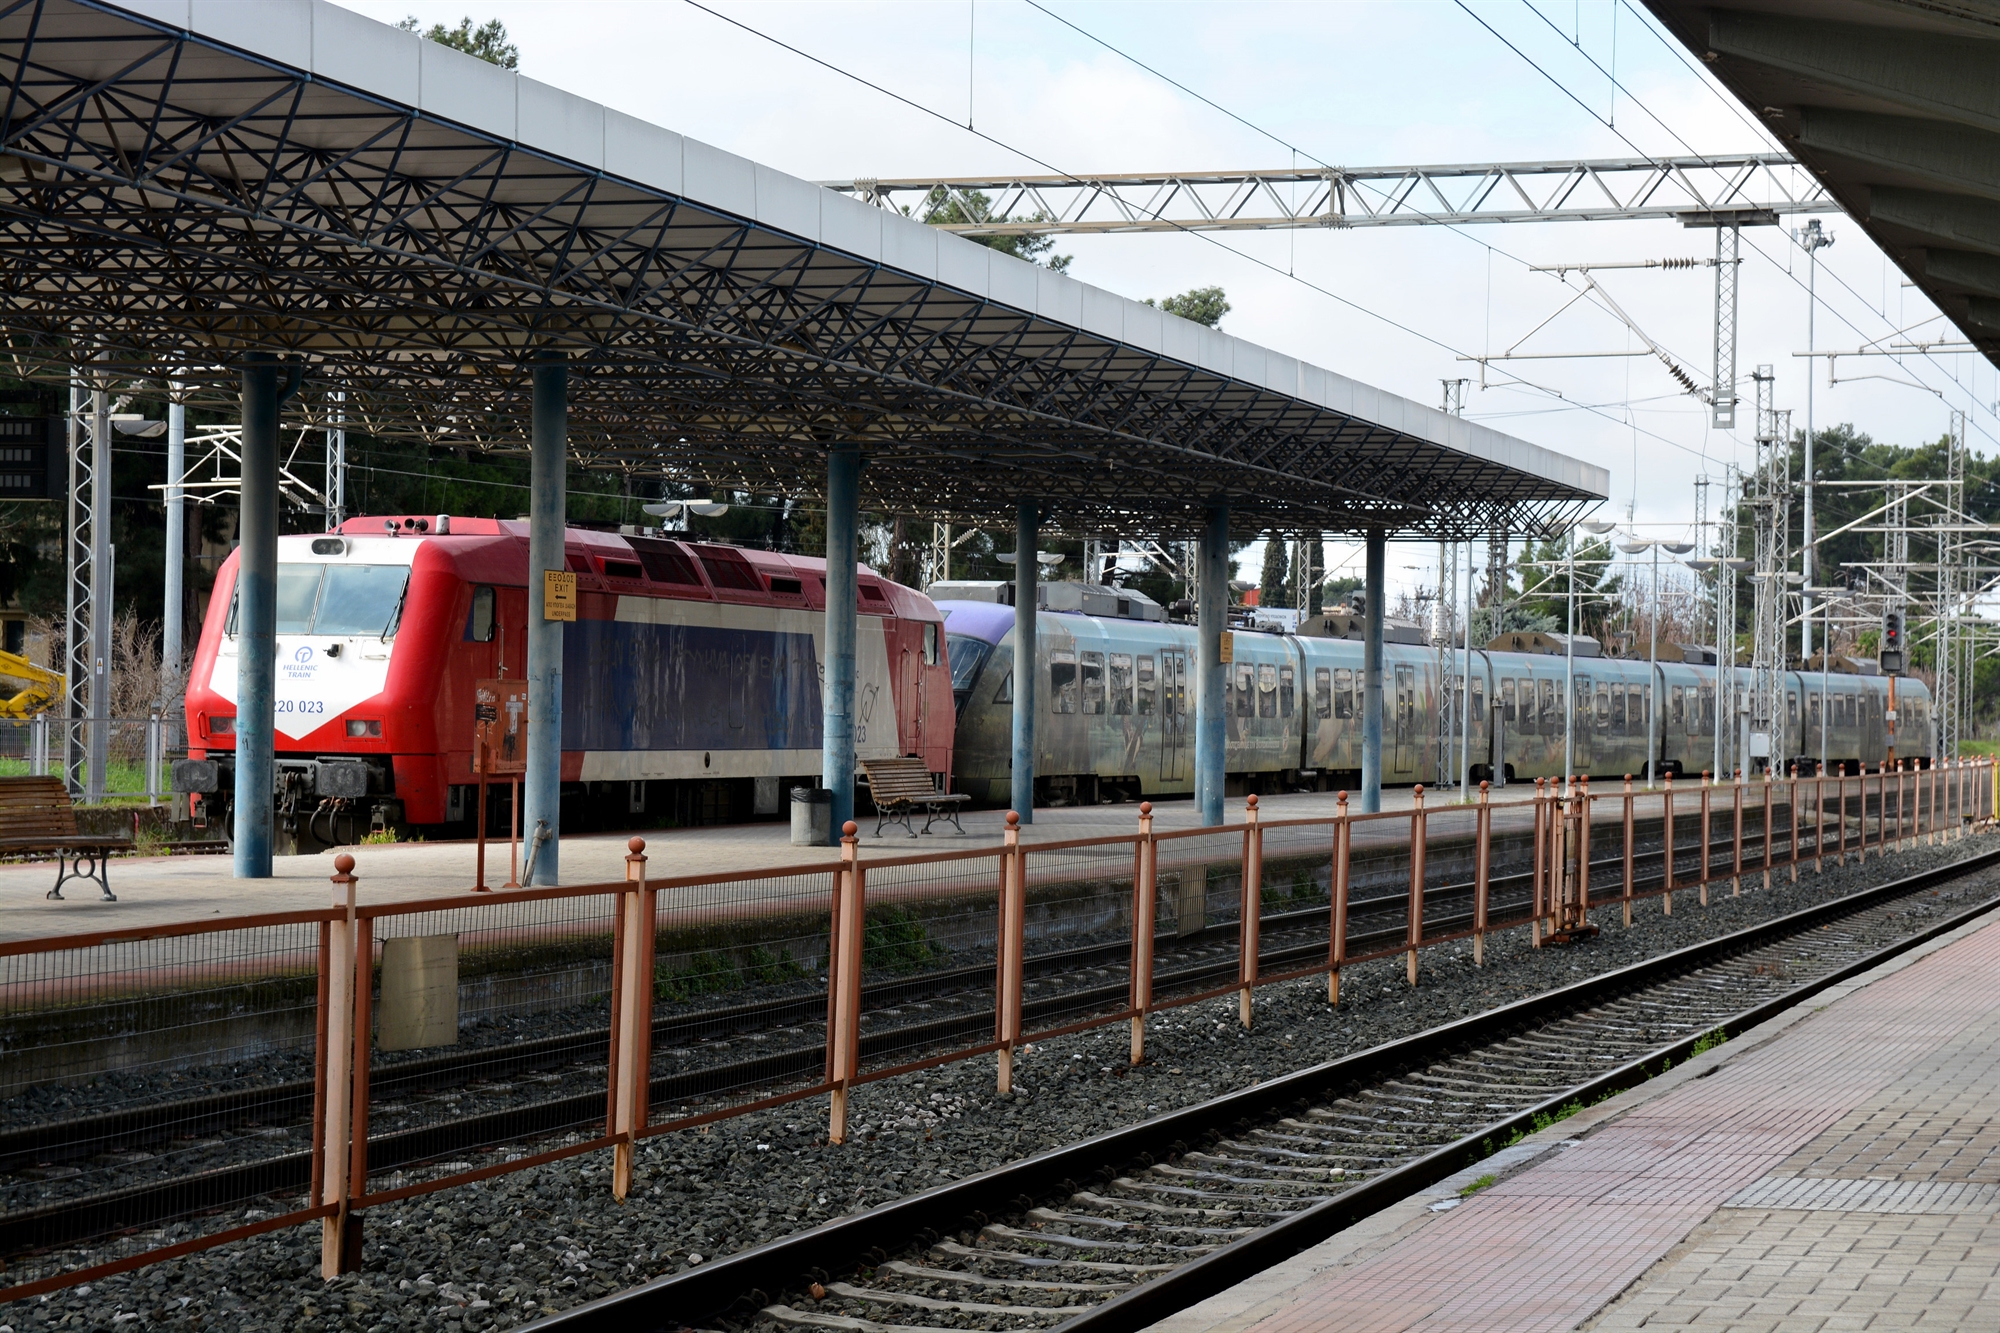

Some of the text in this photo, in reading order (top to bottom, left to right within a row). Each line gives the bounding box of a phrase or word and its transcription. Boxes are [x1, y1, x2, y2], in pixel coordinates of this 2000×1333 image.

[548, 573, 574, 583] ΕΞΟΔΟΣ
[555, 584, 568, 592] EXIT
[299, 700, 324, 713] 023
